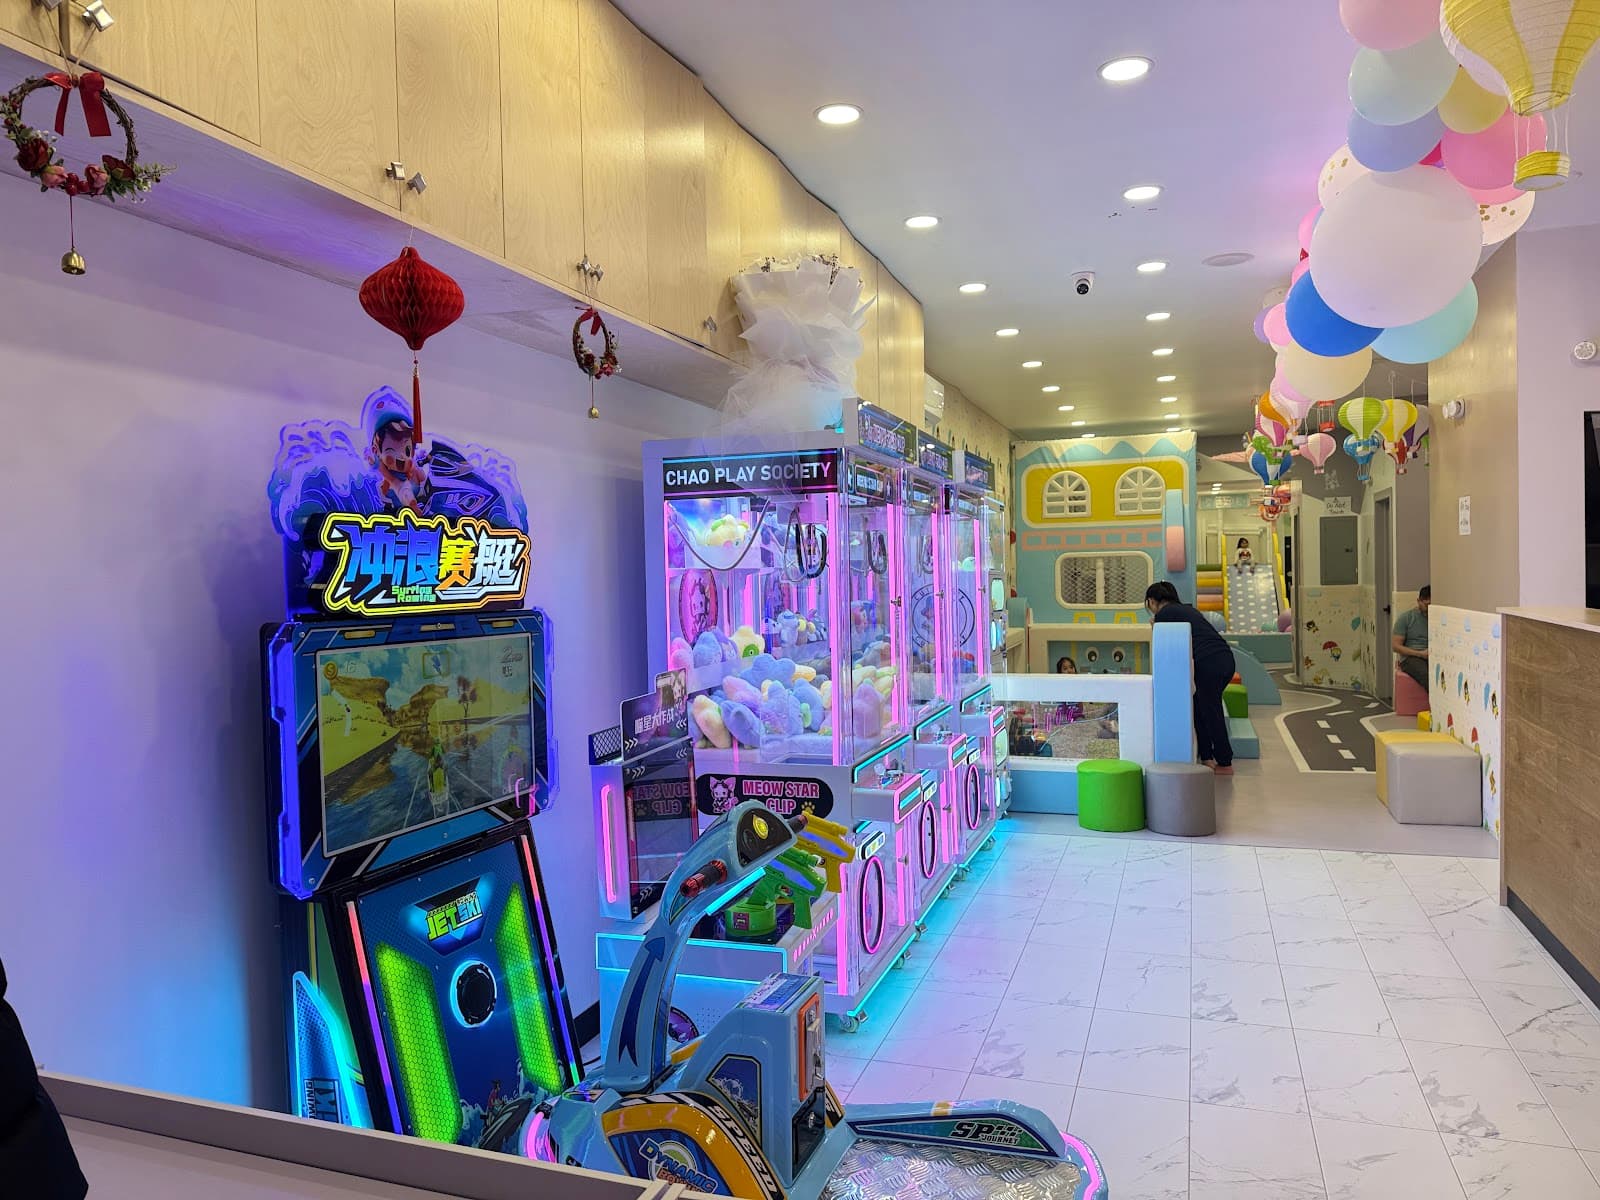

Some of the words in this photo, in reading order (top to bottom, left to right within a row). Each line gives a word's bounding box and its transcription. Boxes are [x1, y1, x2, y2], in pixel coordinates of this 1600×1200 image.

[665, 468, 710, 486] CHAO
[714, 465, 756, 483] PLAY
[760, 461, 832, 481] SOCIETY
[332, 524, 524, 599] 冲浪赛艇
[742, 779, 783, 798] MEOW
[785, 782, 820, 799] STAR
[766, 798, 796, 814] CLIP
[427, 906, 459, 941] JET
[457, 896, 483, 923] SKI
[949, 1121, 996, 1140] SP
[639, 1138, 718, 1194] DYNAMIC
[707, 1105, 779, 1195] SPEED
